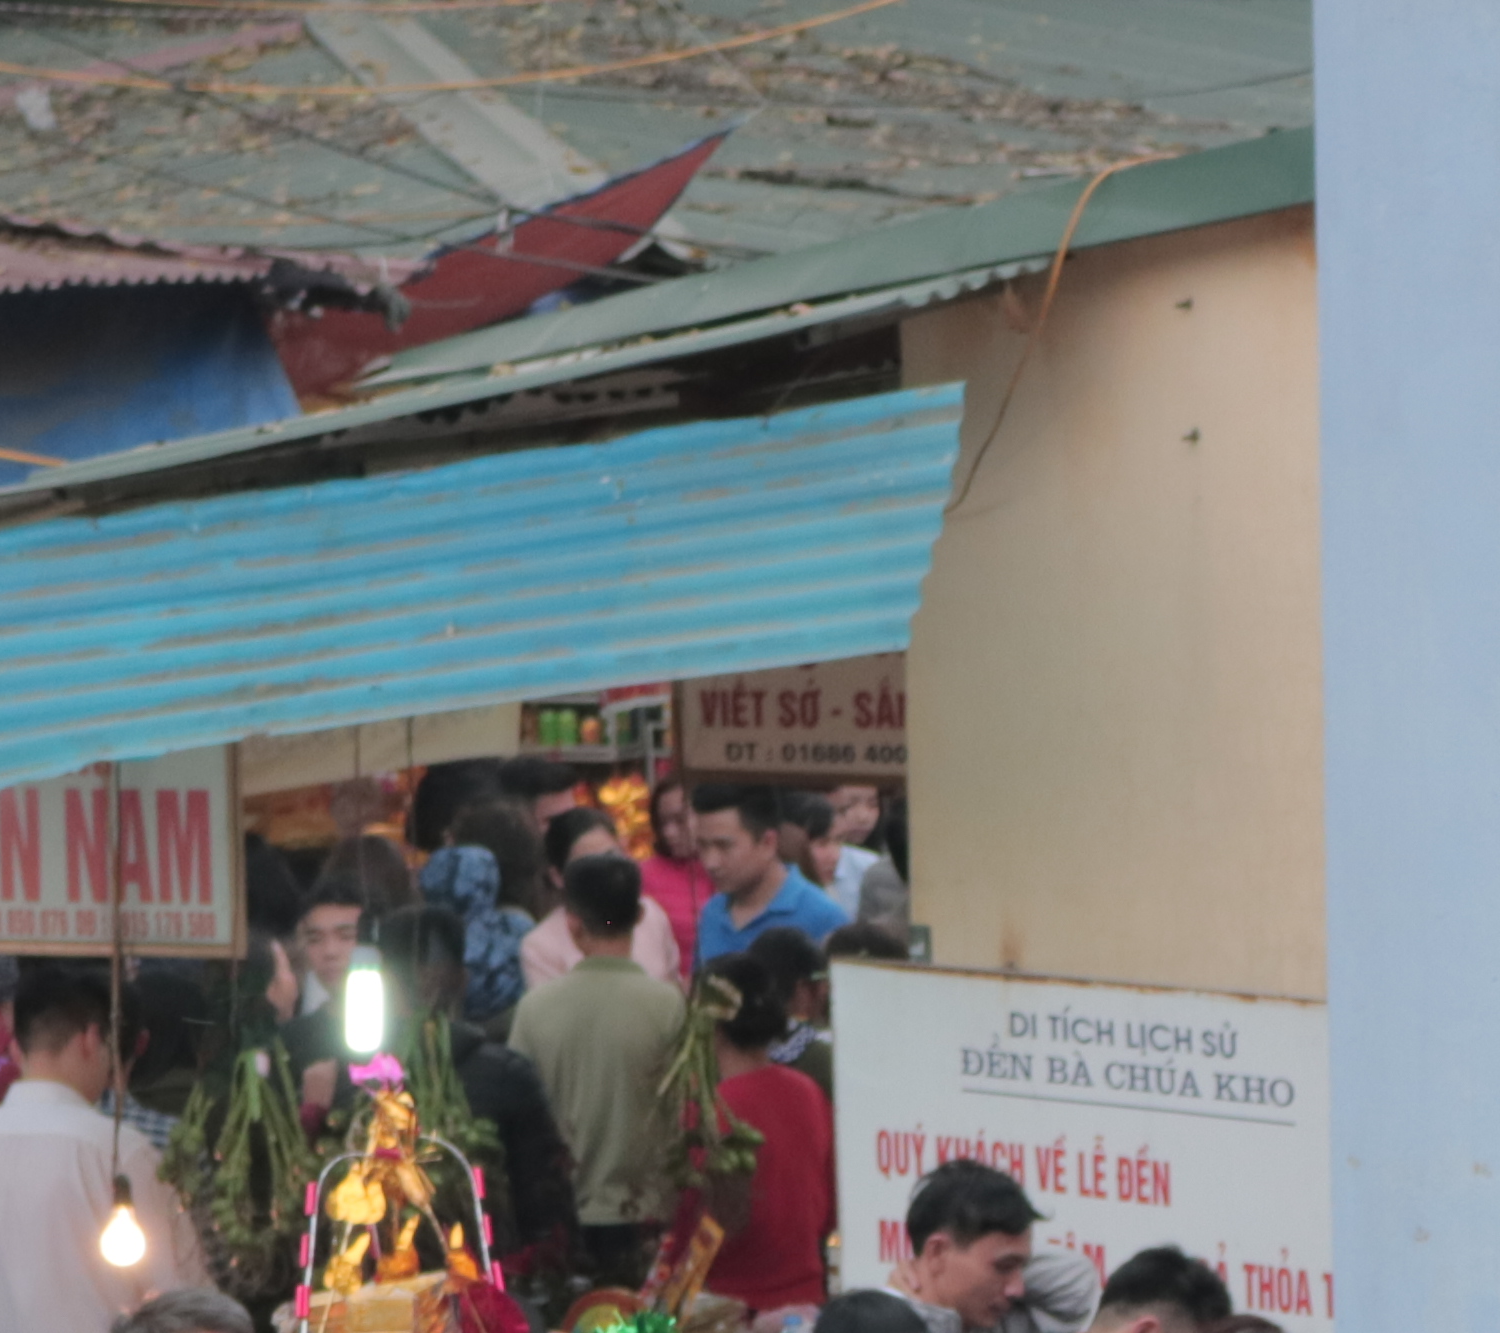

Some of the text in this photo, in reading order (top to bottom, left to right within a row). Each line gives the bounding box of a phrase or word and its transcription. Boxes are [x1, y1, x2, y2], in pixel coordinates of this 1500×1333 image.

[64, 788, 213, 904] NAM
[1009, 1010, 1037, 1039] DI
[1048, 1005, 1115, 1047] TÍCH
[1126, 1020, 1192, 1057] LỊCH
[1104, 1057, 1202, 1099] CHÚA
[1214, 1071, 1295, 1108] KHO
